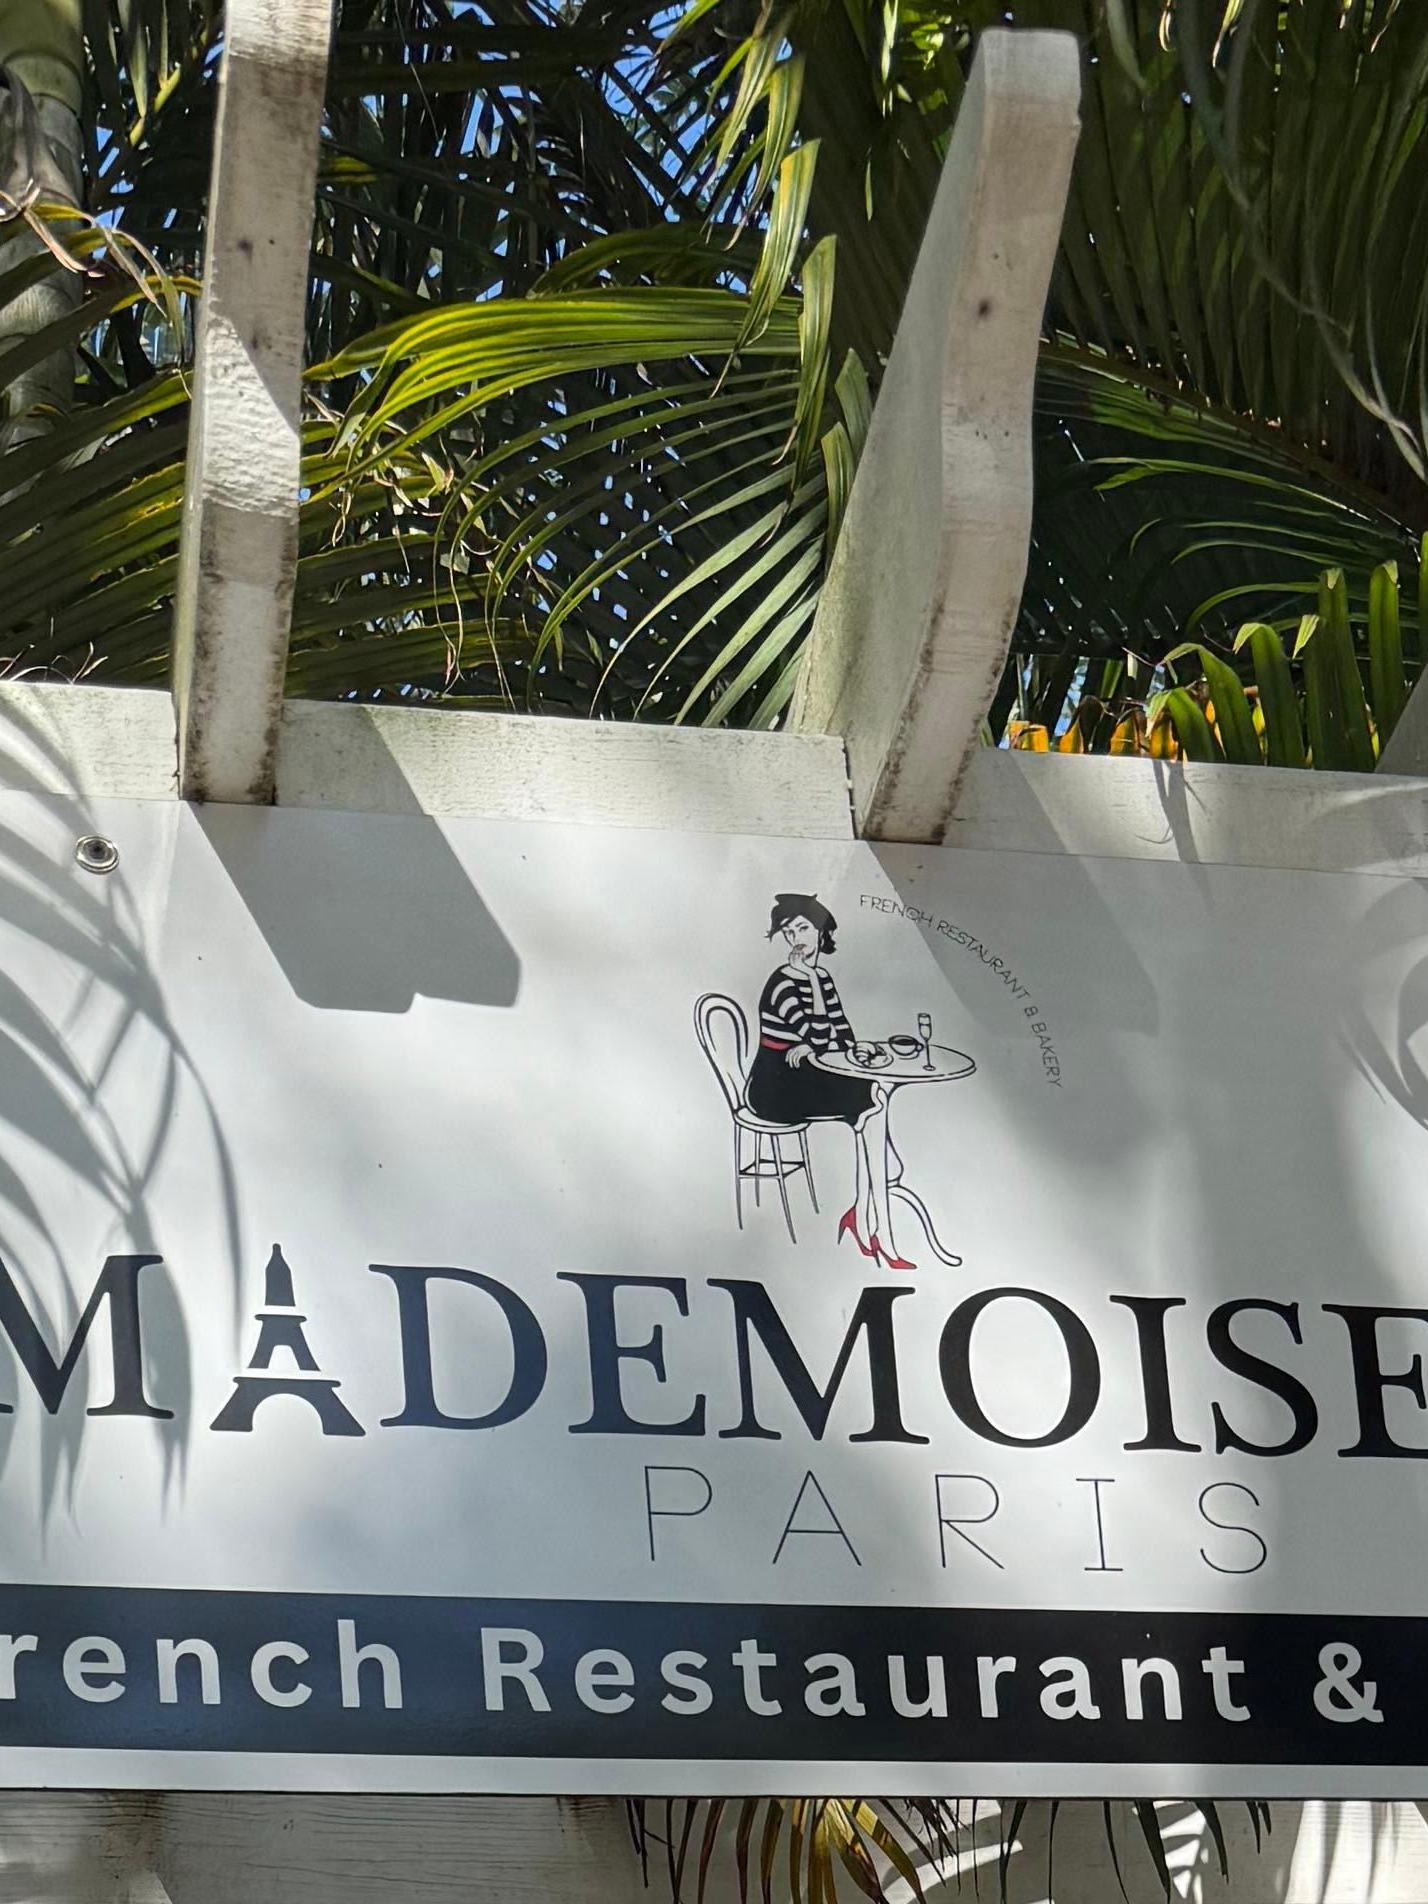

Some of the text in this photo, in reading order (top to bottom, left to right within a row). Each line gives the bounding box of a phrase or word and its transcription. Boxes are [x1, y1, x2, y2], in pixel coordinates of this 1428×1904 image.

[859, 893, 934, 929] FRENCH
[936, 919, 1031, 1000] RESTAURANT
[1031, 1021, 1063, 1089] BAKERY
[643, 1464, 1268, 1575] PARIS
[480, 1626, 1252, 1722] Restaurant
[1313, 1642, 1385, 1724] &
